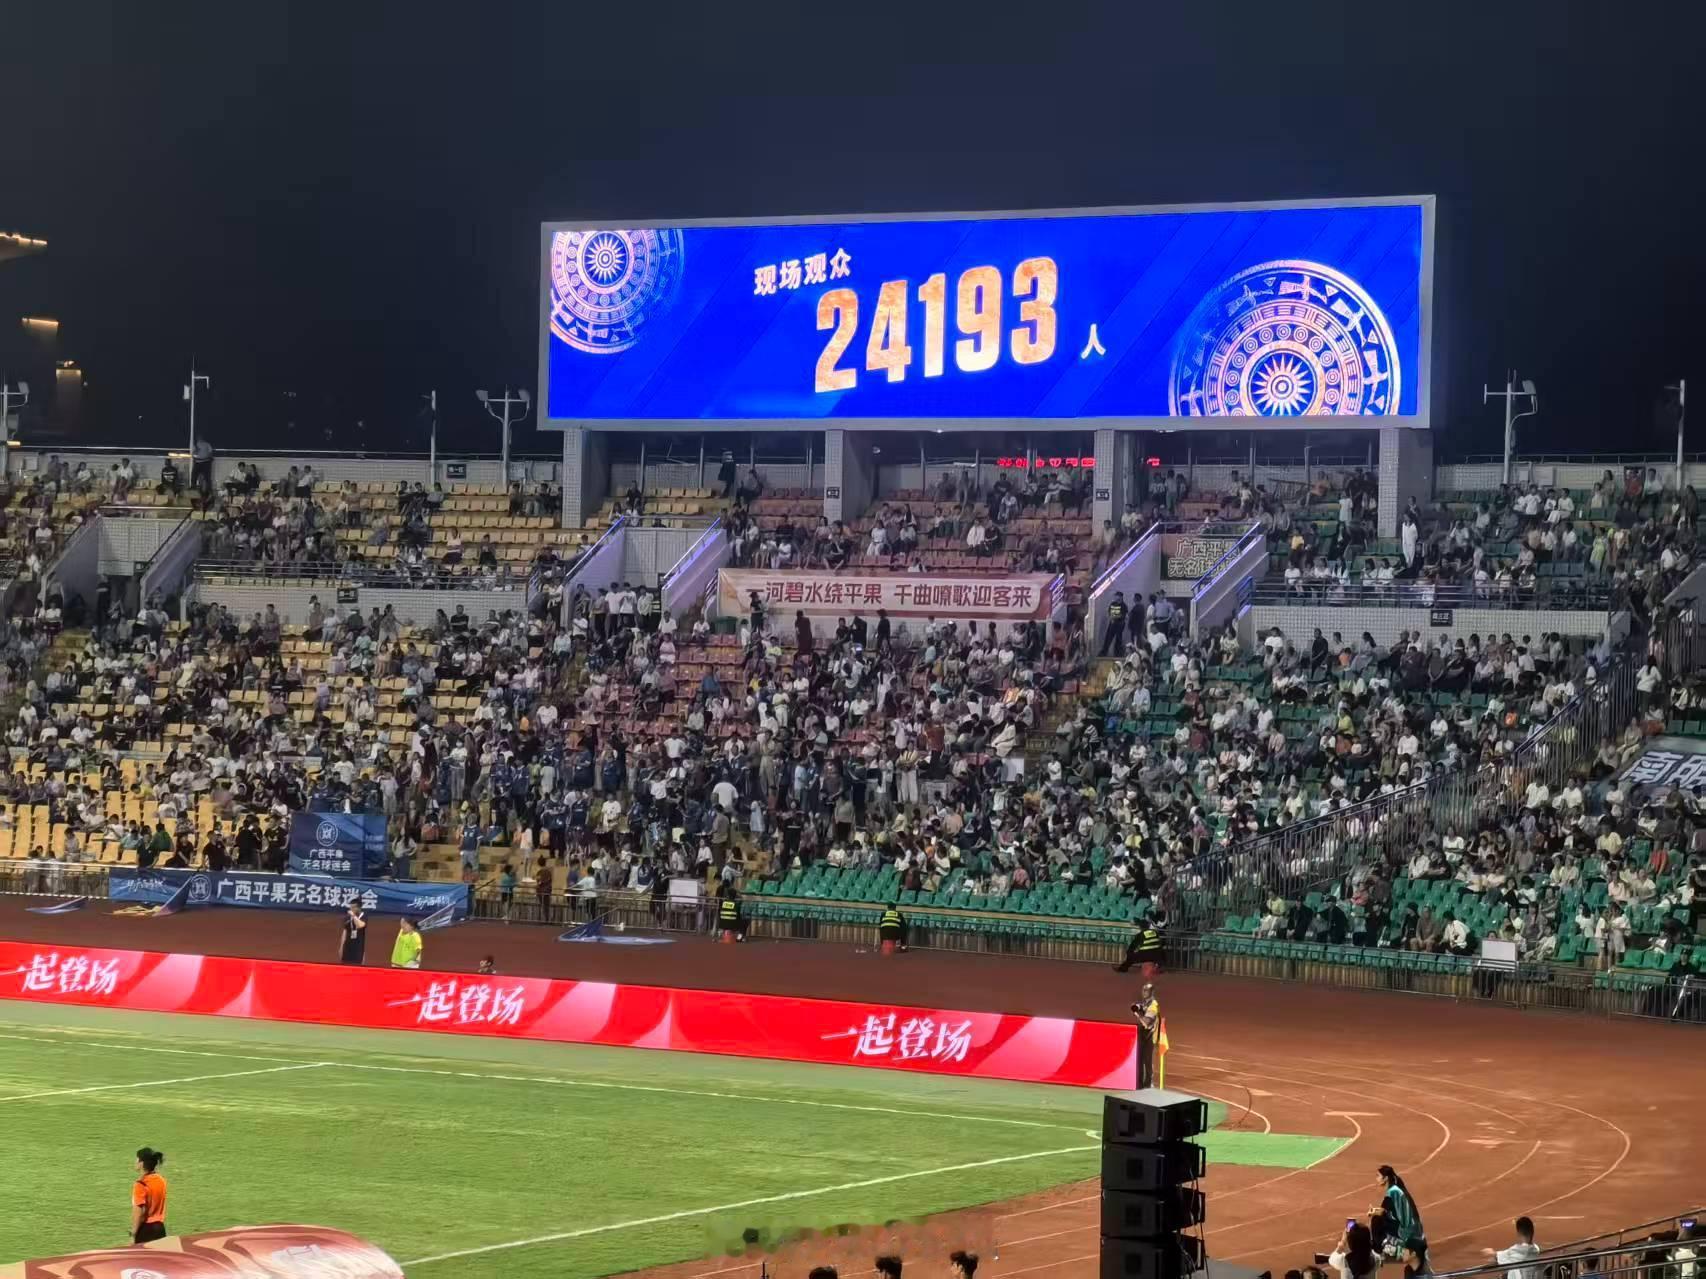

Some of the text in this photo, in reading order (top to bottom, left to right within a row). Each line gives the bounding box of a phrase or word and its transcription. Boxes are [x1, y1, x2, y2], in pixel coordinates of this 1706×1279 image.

[753, 247, 852, 297] 现场观众
[814, 256, 1107, 394] 24193 人
[745, 581, 1032, 608] 一河碧水绕平果 千曲嘹歌迎客来
[302, 859, 352, 872] 无名球迷会
[216, 877, 378, 910] 广西平果无名球迷会
[0, 952, 120, 995] 一起登场
[387, 980, 525, 1024] 一起登场
[820, 1012, 972, 1062] 一起登场
